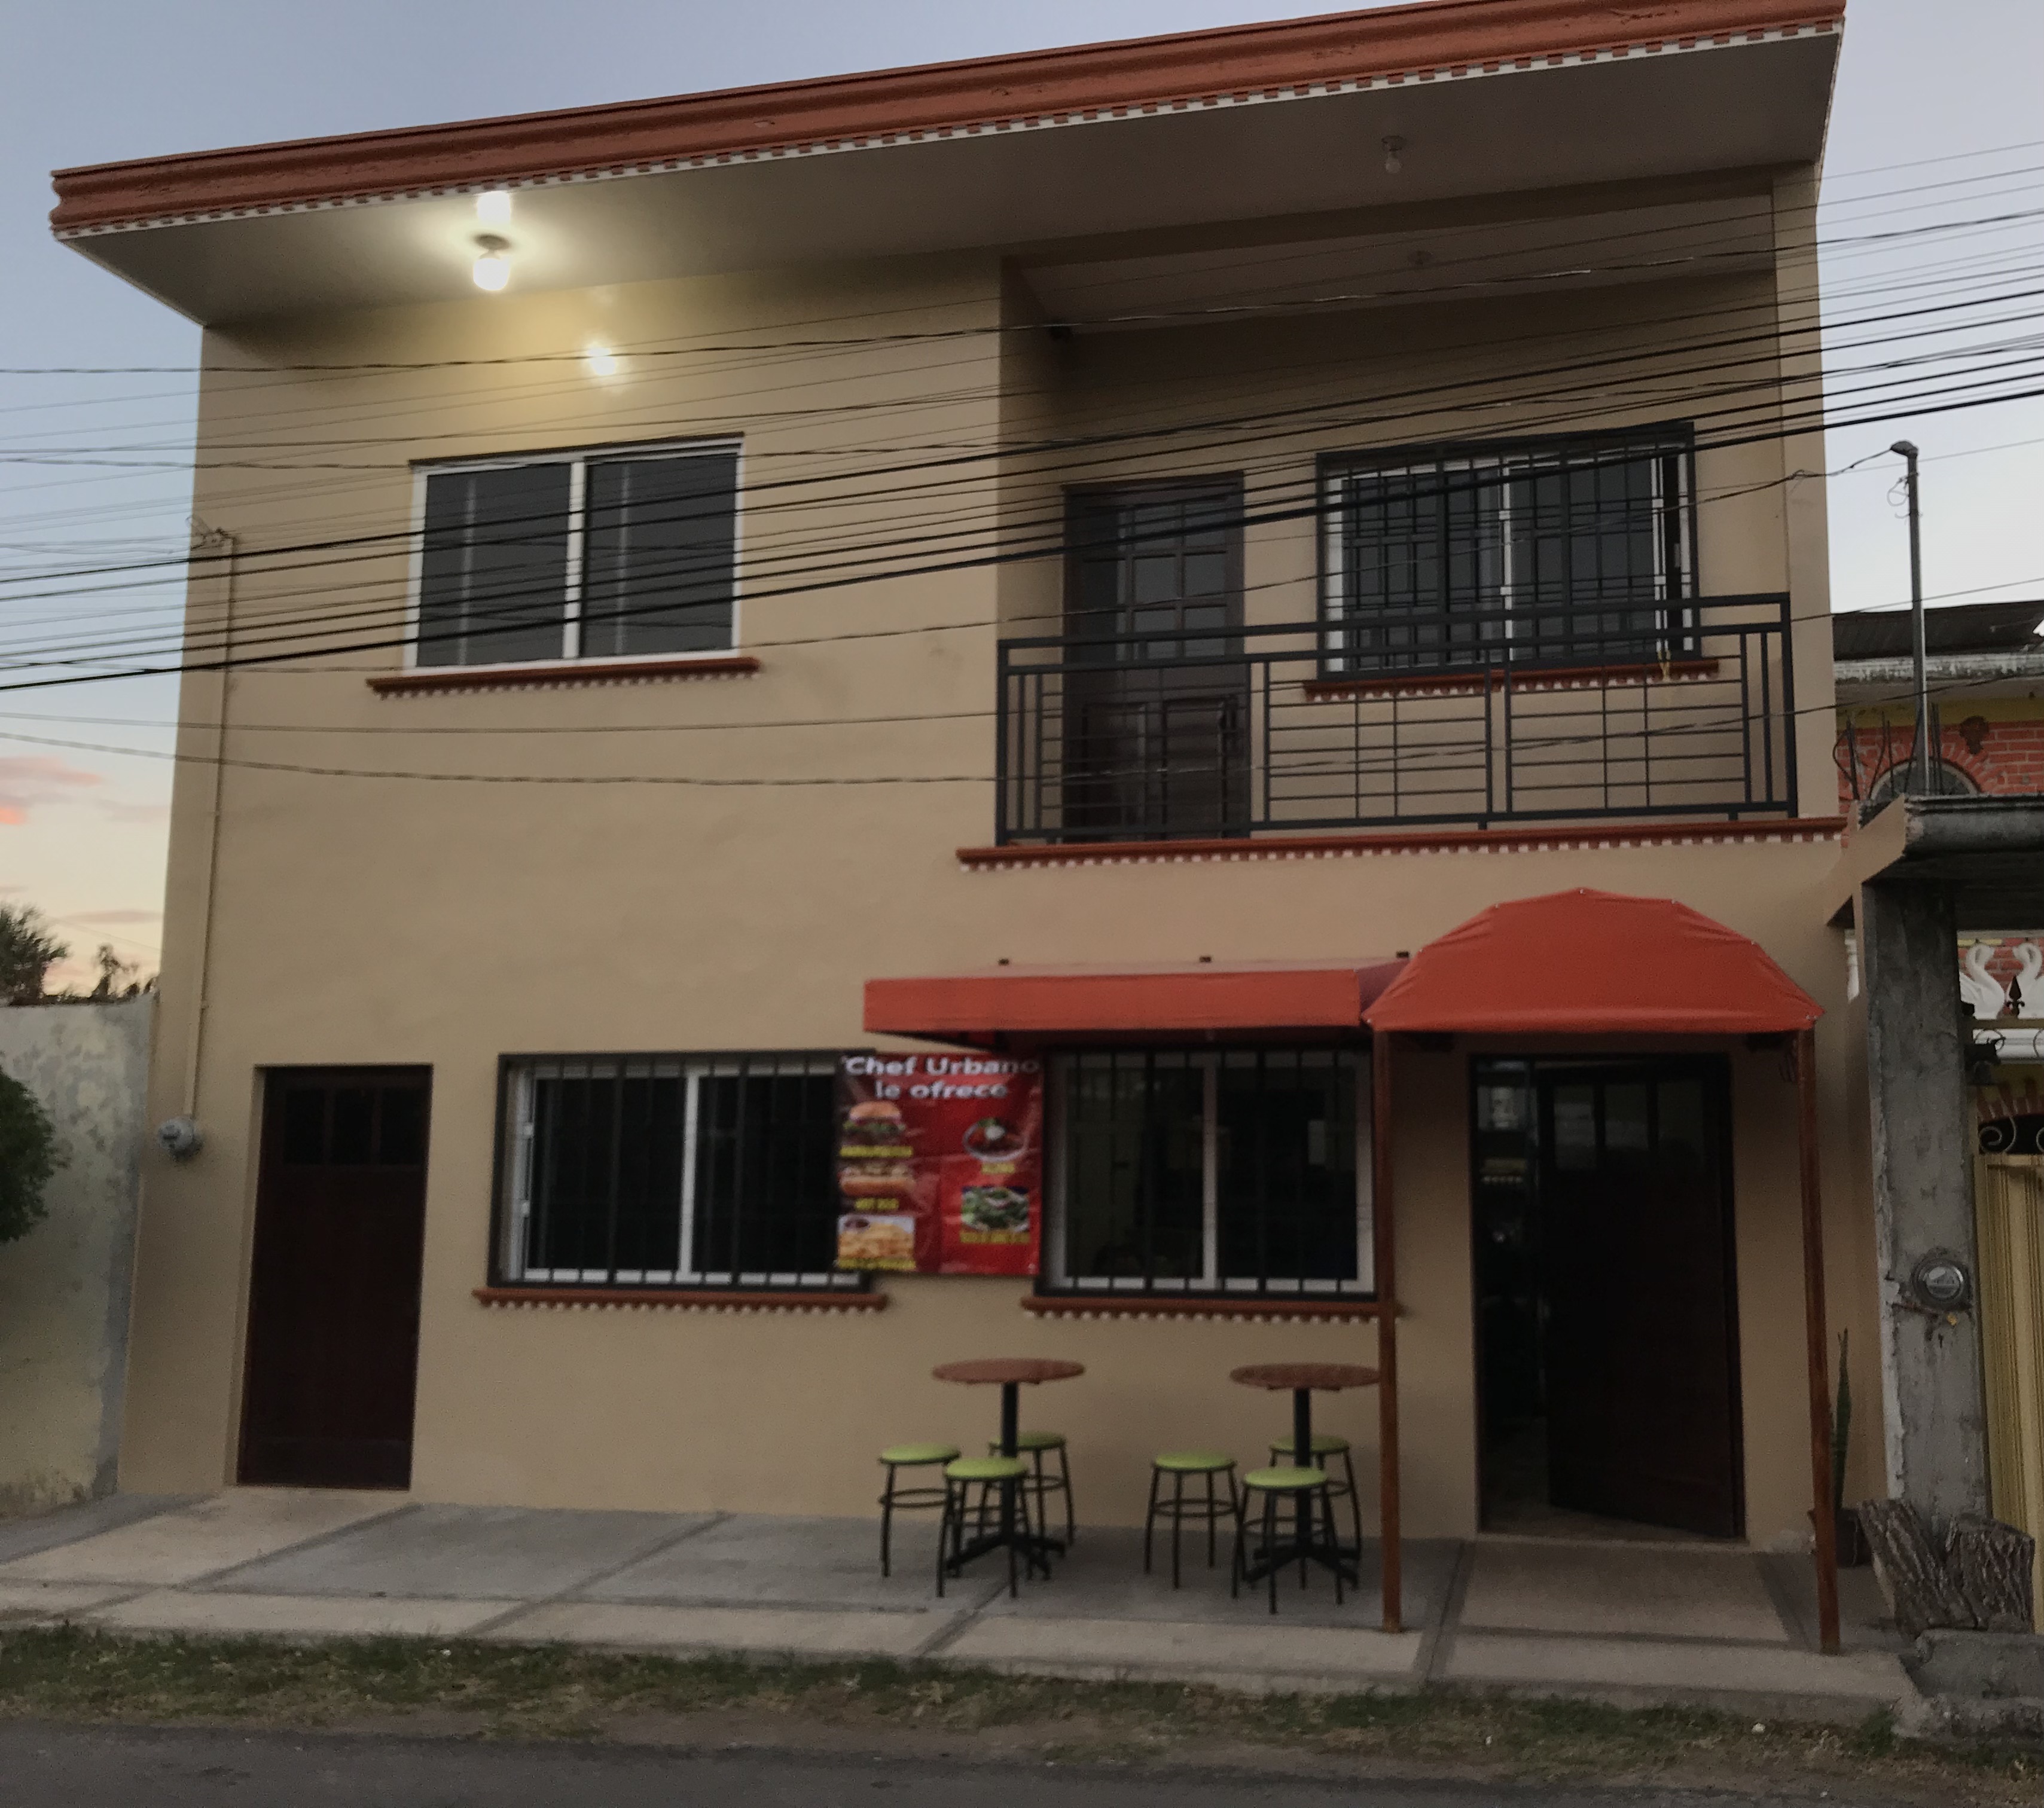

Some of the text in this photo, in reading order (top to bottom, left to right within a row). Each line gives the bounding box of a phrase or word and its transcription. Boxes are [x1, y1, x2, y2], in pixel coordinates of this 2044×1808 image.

[845, 1056, 1040, 1075] Chef Urbano
[875, 1080, 1008, 1099] le ofrece
